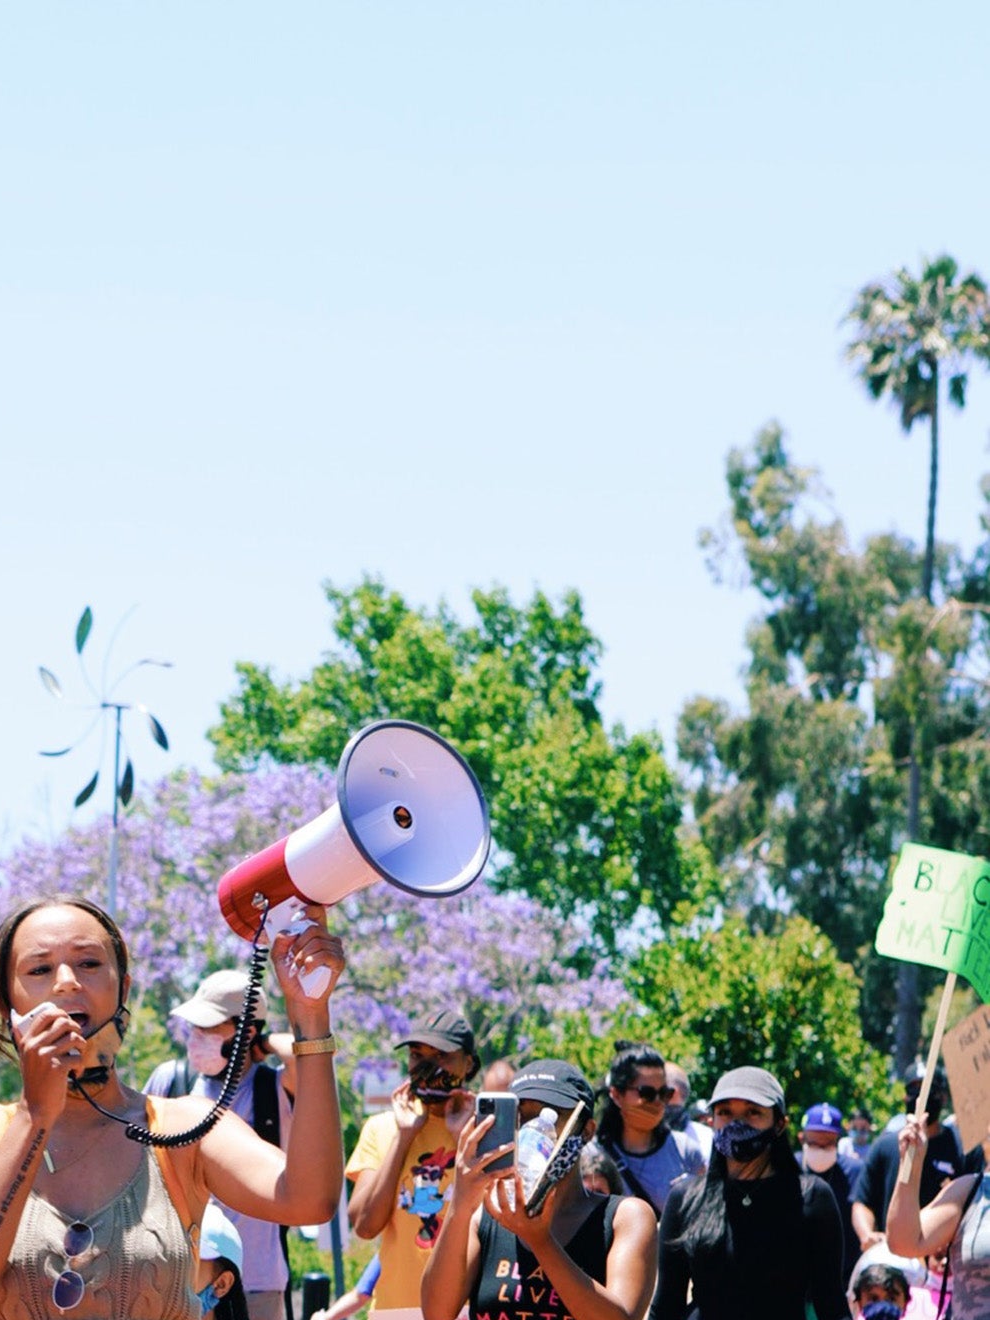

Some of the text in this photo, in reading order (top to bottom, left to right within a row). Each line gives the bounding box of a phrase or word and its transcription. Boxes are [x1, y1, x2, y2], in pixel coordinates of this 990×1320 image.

[914, 860, 990, 906] BLAC
[0, 1173, 26, 1213] strong
[20, 1128, 46, 1173] survive
[495, 1260, 545, 1281] BLA
[498, 1283, 560, 1306] LIVE
